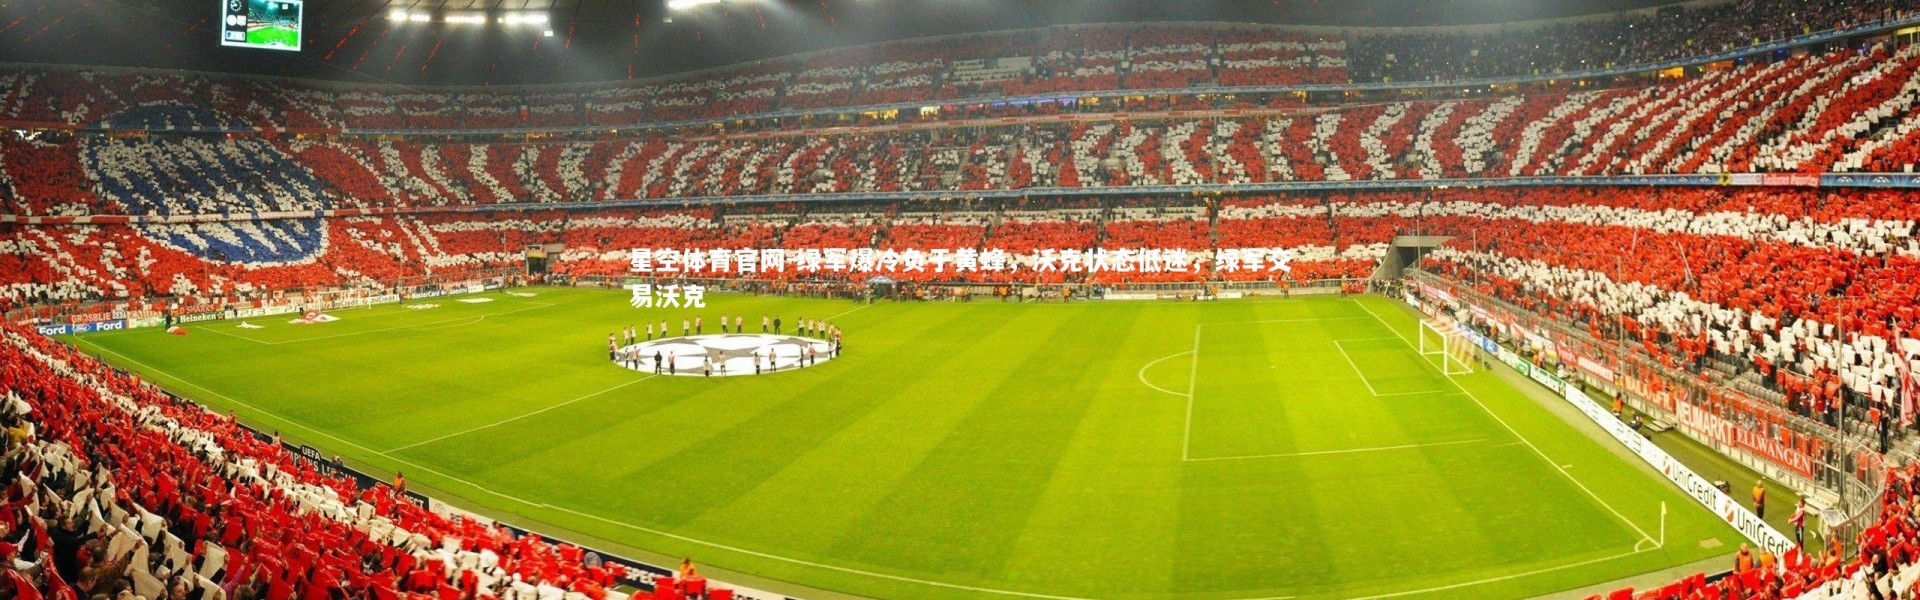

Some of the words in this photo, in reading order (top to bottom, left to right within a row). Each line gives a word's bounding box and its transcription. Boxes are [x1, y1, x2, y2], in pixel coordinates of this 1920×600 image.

[180, 312, 217, 324] Heineken
[39, 325, 67, 336] Ford
[97, 320, 123, 332] Ford
[1676, 398, 1734, 447] NEUMARKT
[301, 446, 321, 461] UEFA
[1737, 425, 1812, 475] ELLWANGEN
[1673, 462, 1717, 511] UniCredit
